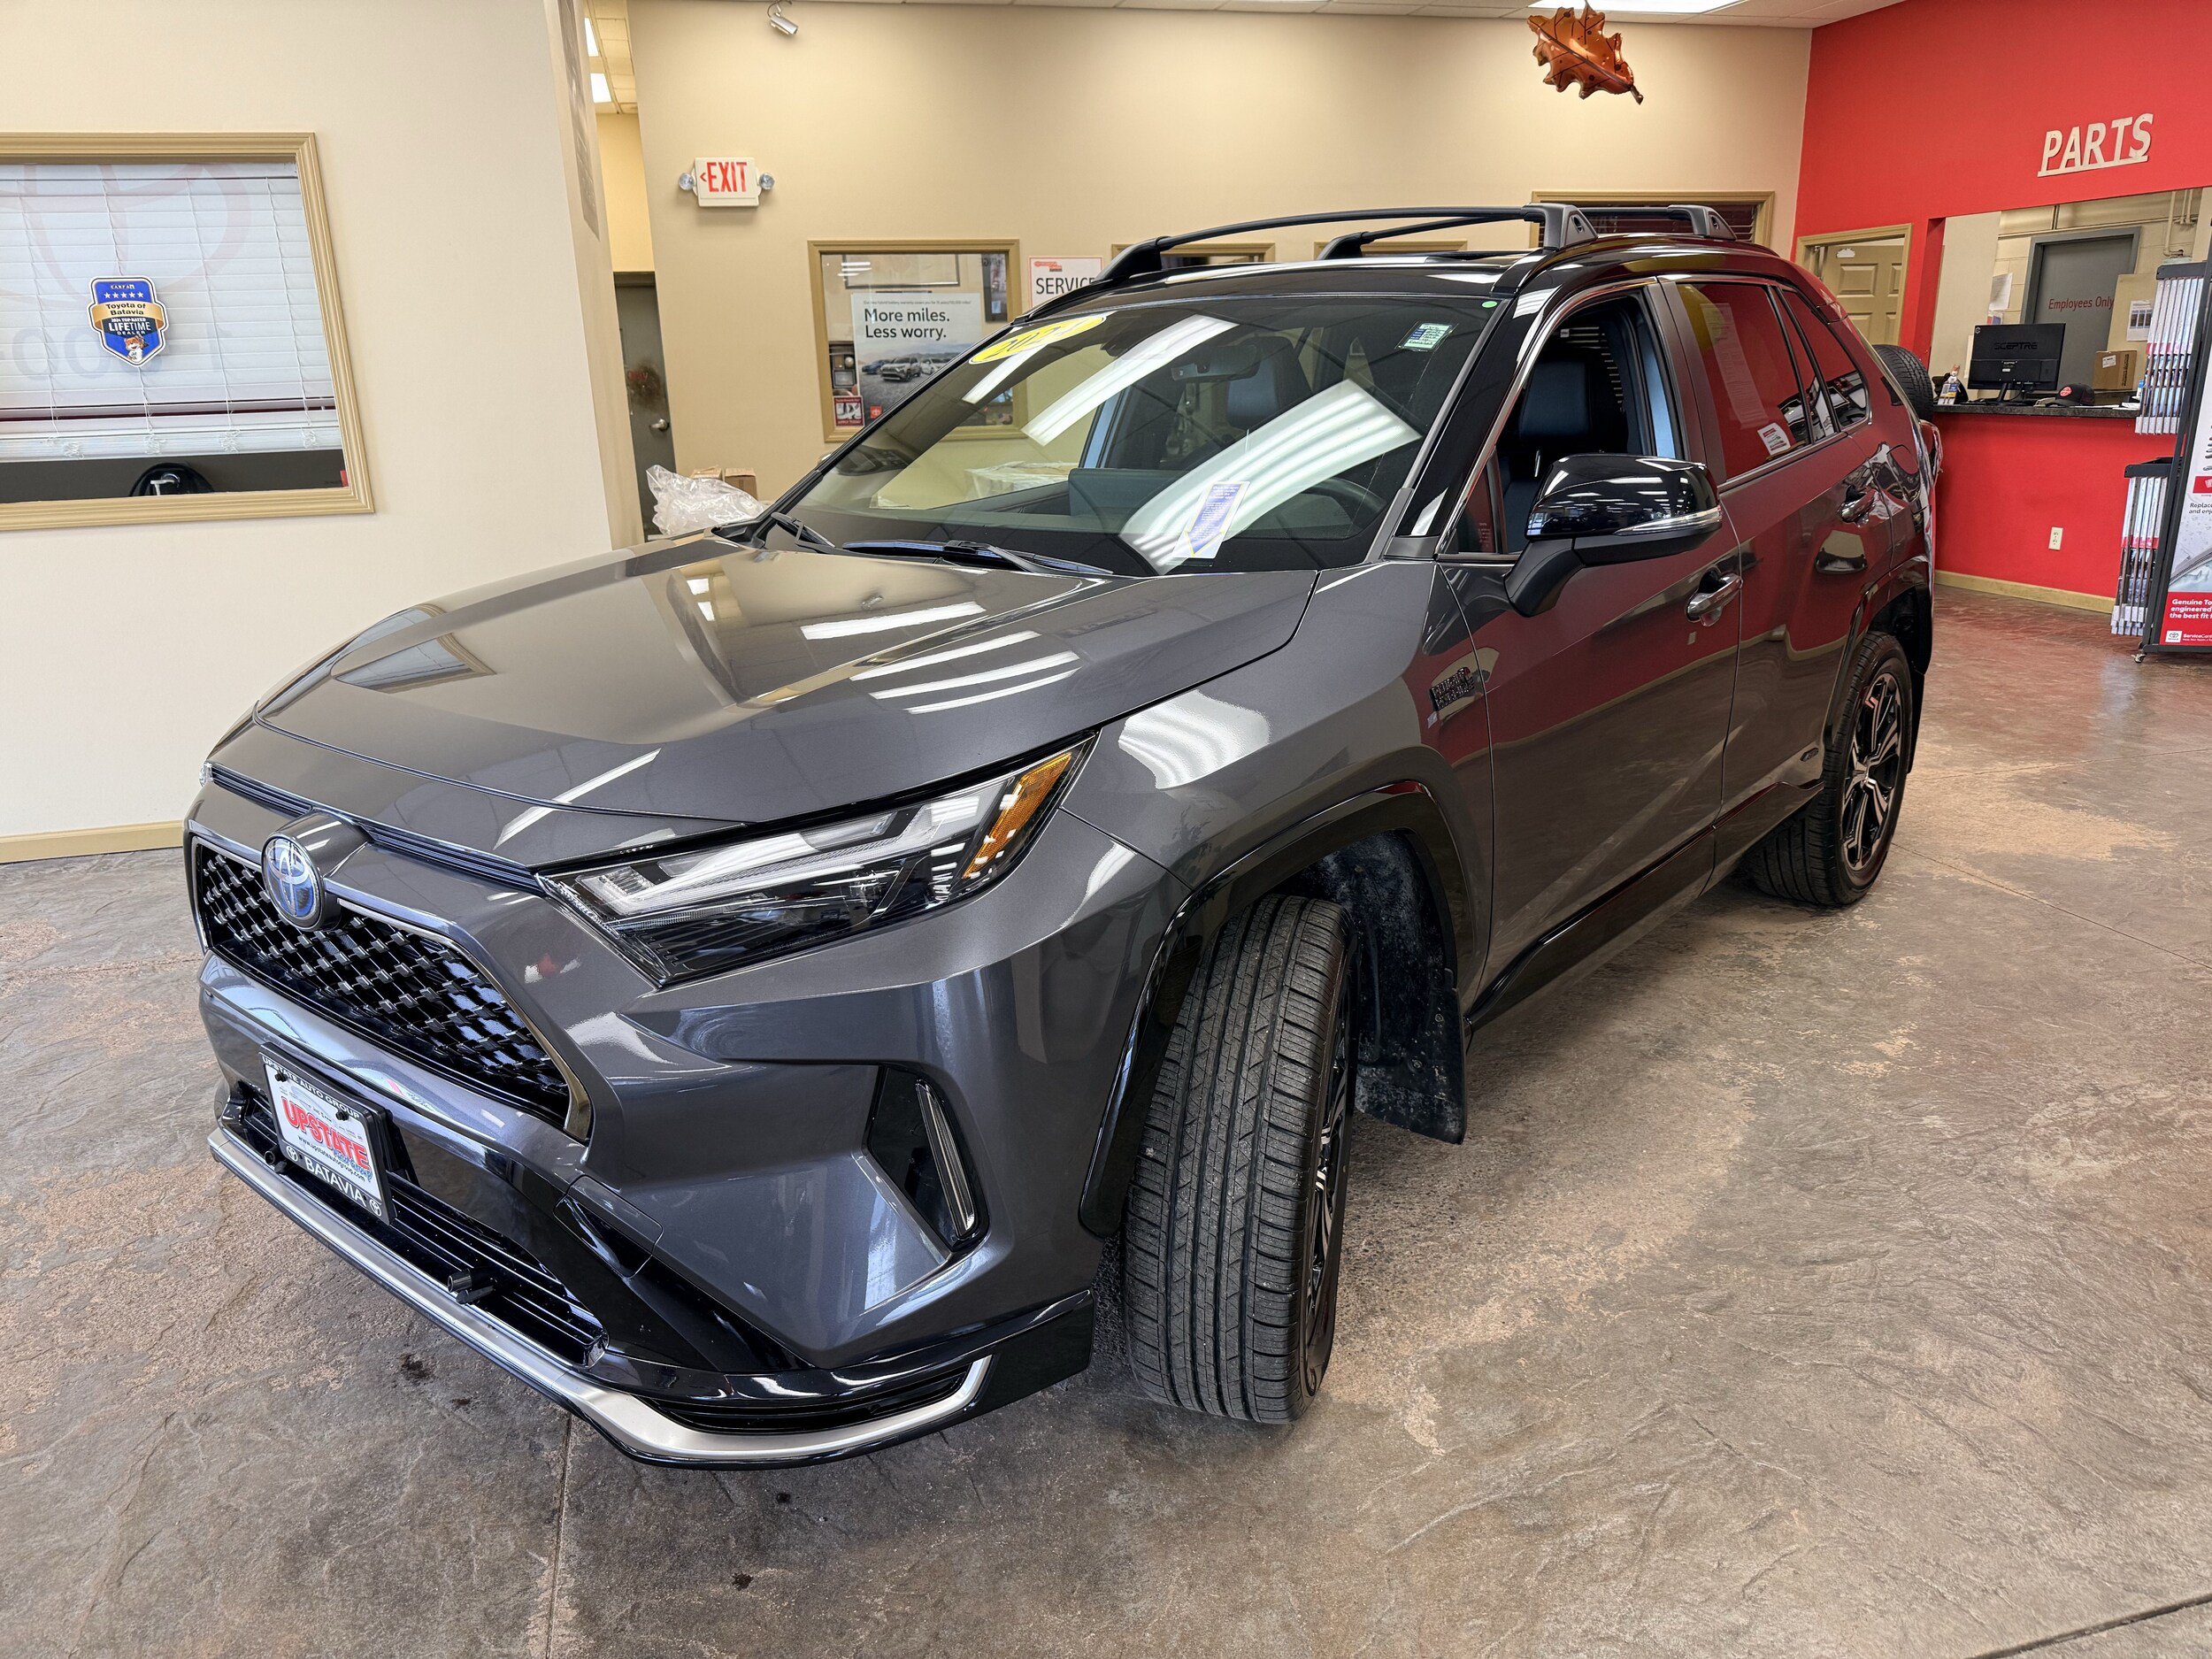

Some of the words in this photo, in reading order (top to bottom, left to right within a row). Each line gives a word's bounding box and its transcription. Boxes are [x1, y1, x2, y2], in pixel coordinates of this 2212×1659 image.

[2037, 113, 2154, 177] PARTS
[707, 162, 747, 192] EXIT
[864, 308, 903, 322] More
[907, 307, 950, 322] miles.
[2048, 298, 2093, 311] Employees
[2095, 296, 2115, 310] Only
[108, 322, 151, 332] LIFETIME
[865, 325, 897, 338] Less
[901, 327, 947, 342] worry.
[1993, 342, 2039, 351] SCEPTRE
[262, 1056, 299, 1082] UPSTATE
[300, 1080, 324, 1098] AUTO
[325, 1095, 360, 1118] GROUP
[281, 1096, 372, 1171] UPSTATE
[304, 1156, 367, 1208] BATAVIA
